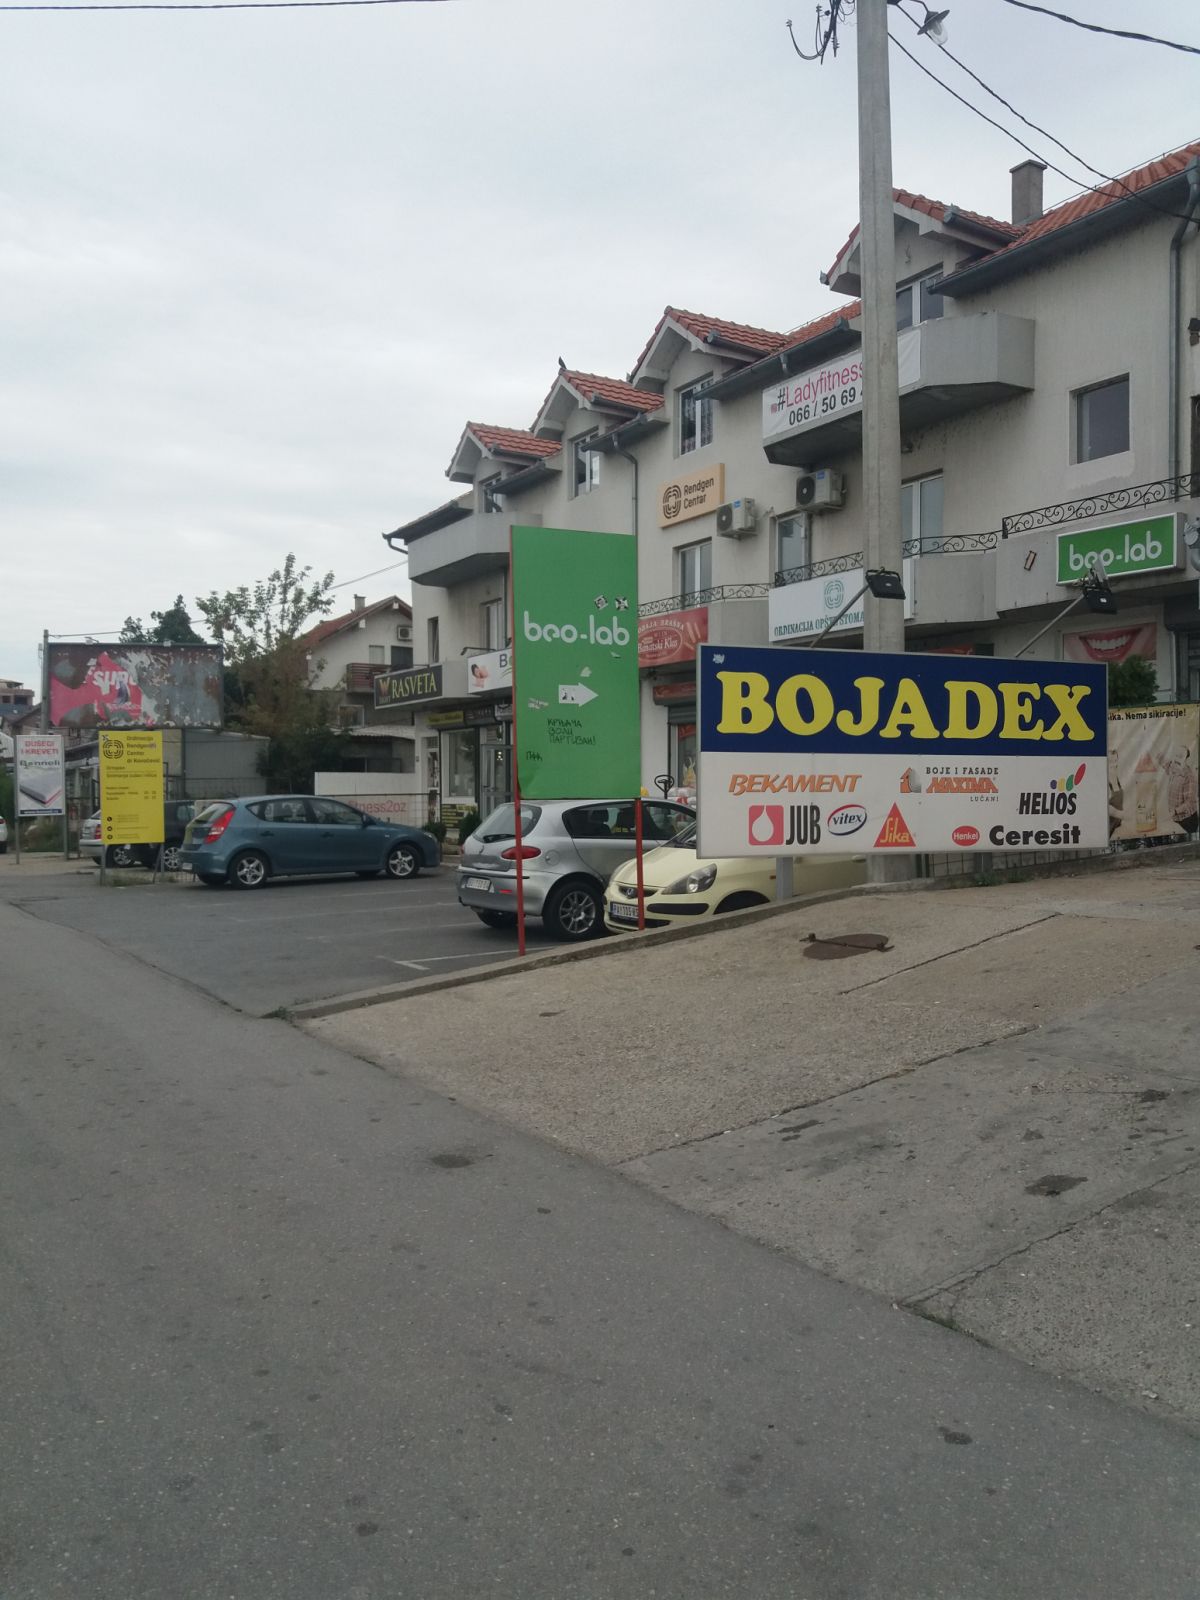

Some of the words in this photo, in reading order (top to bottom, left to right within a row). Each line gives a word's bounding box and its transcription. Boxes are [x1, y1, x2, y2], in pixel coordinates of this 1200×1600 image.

[788, 404, 811, 426] 066
[821, 394, 837, 413] 50
[840, 387, 857, 406] 69
[683, 477, 715, 495] Rendgen
[683, 494, 707, 509] Centar
[1069, 531, 1162, 572] beo-lab
[523, 610, 630, 646] beo-lab
[392, 672, 437, 699] RASVETA
[716, 670, 1095, 742] BOJADEX
[1125, 711, 1147, 720] Nema
[1148, 708, 1186, 719] sikiracije!
[925, 766, 951, 775] BOJE
[954, 767, 958, 775] I
[962, 767, 999, 775] FASADE
[728, 774, 862, 796] BEKAMENT
[926, 776, 999, 794] MAXIMA
[1018, 792, 1077, 815] HELIOS
[785, 804, 822, 846] JUB
[832, 812, 863, 825] vitex
[880, 816, 910, 844] Sika
[953, 831, 979, 841] Henkel
[988, 822, 1081, 846] Ceresit
